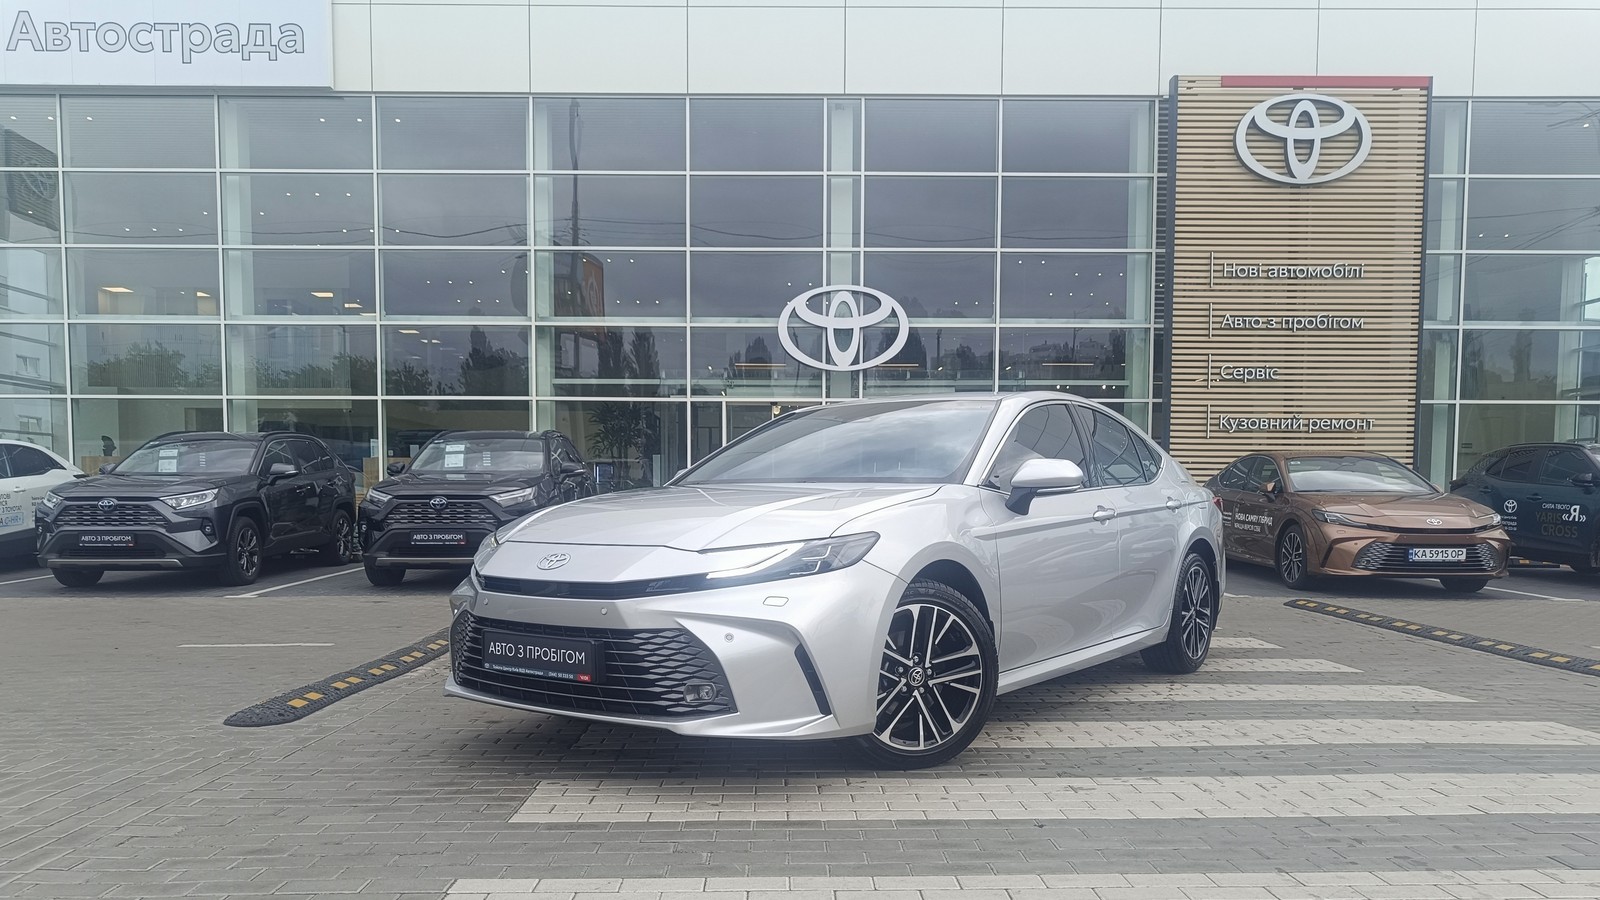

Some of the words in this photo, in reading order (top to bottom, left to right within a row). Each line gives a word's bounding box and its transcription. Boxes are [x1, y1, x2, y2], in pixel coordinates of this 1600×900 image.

[6, 10, 305, 64] Автострада
[1223, 262, 1263, 278] Нові
[1268, 262, 1365, 278] автомобілі
[1221, 313, 1263, 329] Авто
[1266, 318, 1277, 329] з
[1282, 313, 1364, 332] пробігом
[1220, 364, 1280, 383] Сервіс
[1219, 415, 1303, 433] Кузовний
[1309, 418, 1375, 433] ремонт
[1555, 503, 1571, 511] ТВОГО
[1536, 511, 1562, 524] YARIS
[1541, 523, 1578, 538] CROSS
[1429, 549, 1449, 559] 5915
[489, 641, 515, 656] АВТО
[517, 644, 524, 658] З
[526, 646, 586, 664] ПРОБІГОМ
